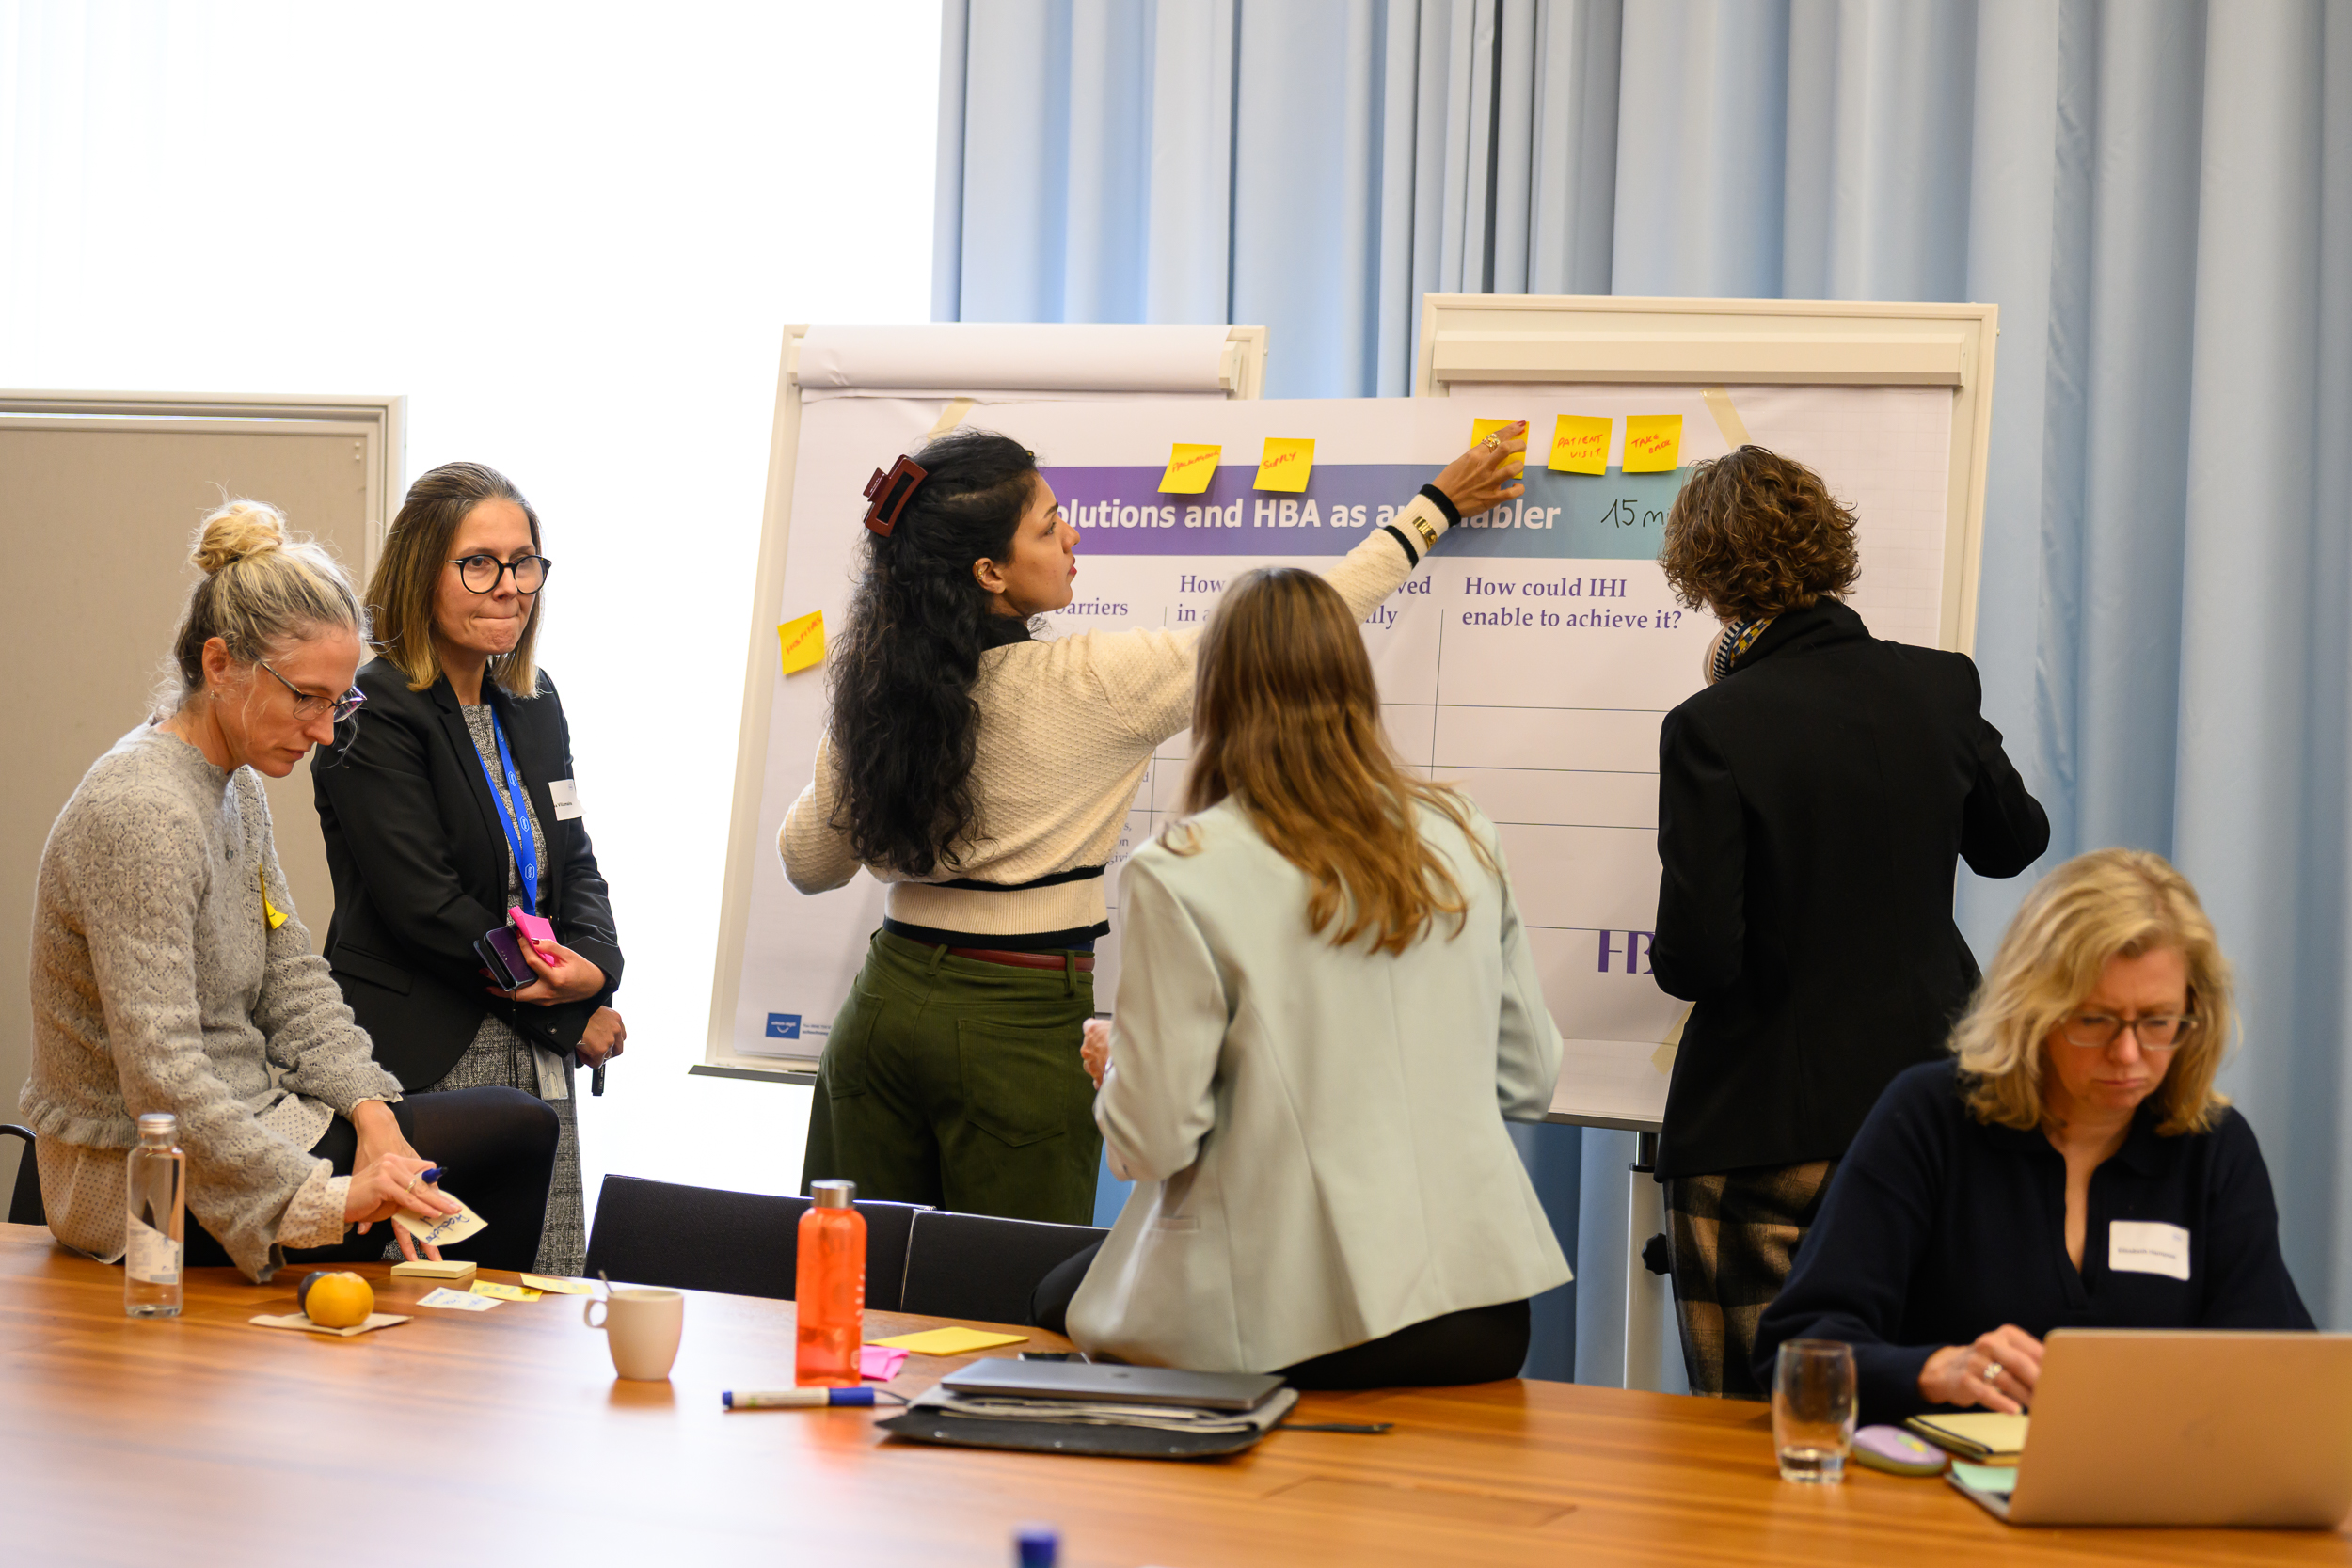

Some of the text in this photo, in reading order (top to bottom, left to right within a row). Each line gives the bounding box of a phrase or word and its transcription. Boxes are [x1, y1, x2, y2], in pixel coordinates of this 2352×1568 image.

[1557, 434, 1603, 449] PATIENT
[1570, 447, 1602, 459] VISIT
[1057, 498, 1562, 530] olutions and HBA as a abler
[1600, 499, 1639, 528] 15
[1179, 574, 1432, 594] How ved
[1464, 577, 1628, 598] How could IHI
[1176, 603, 1196, 622] in
[1462, 607, 1682, 629] enable to achieve it?
[1597, 929, 1656, 974] HB
